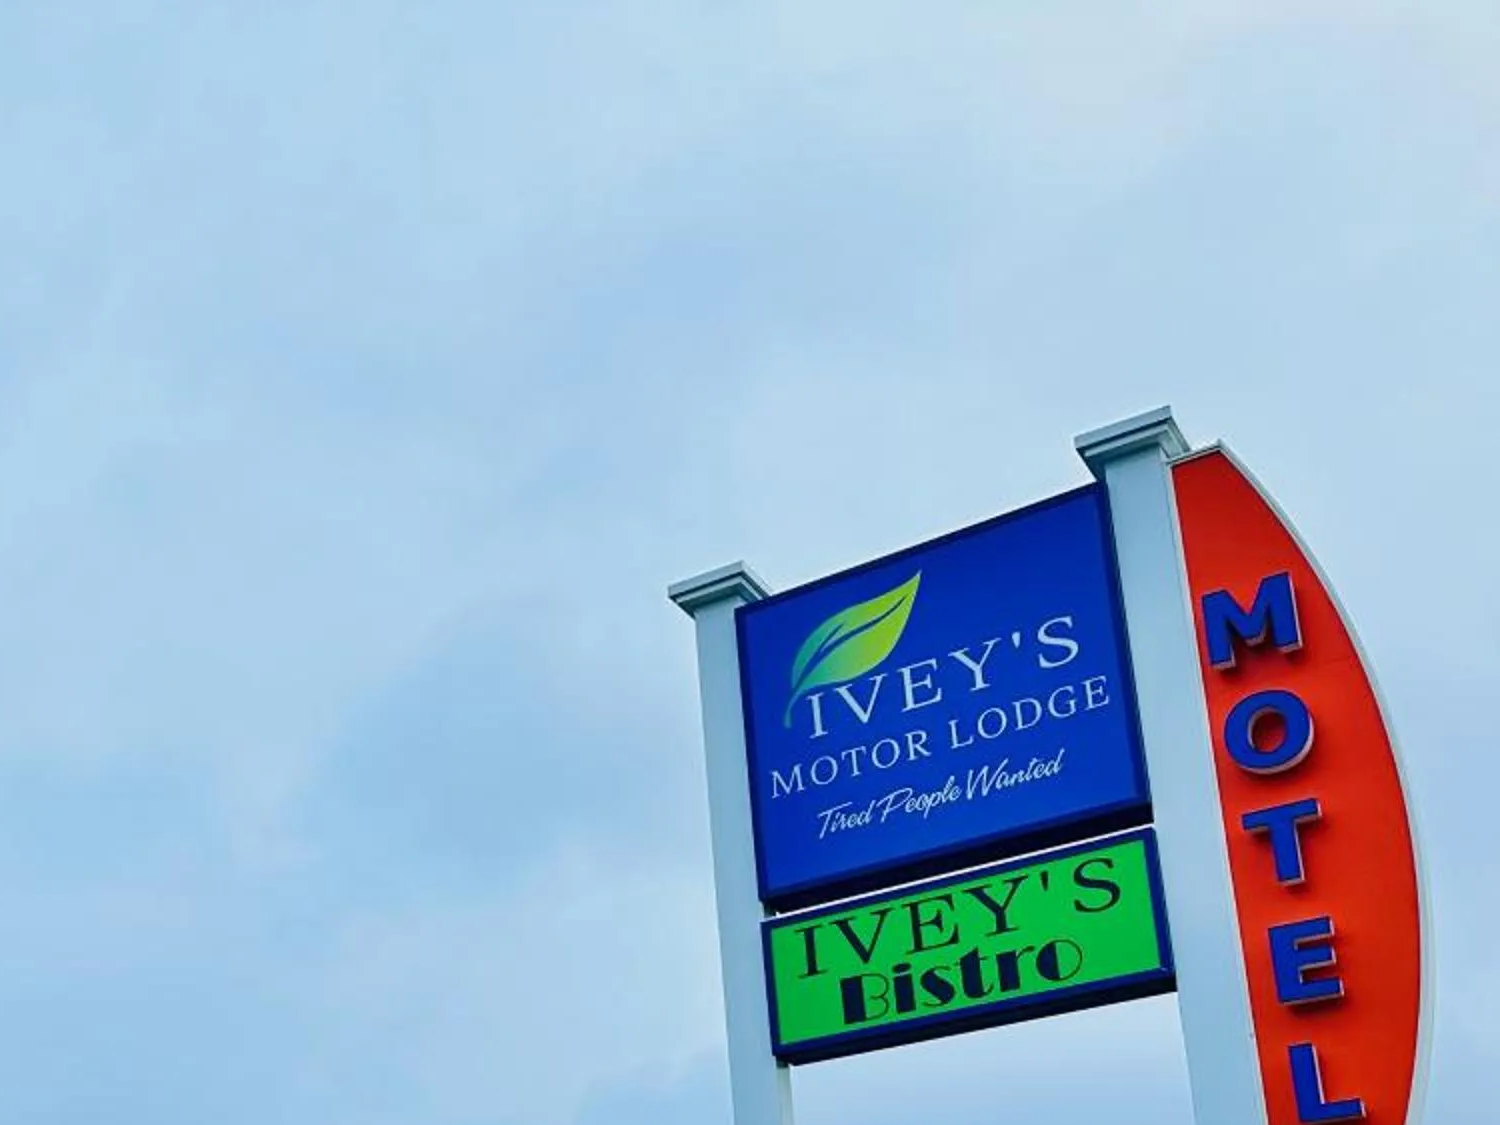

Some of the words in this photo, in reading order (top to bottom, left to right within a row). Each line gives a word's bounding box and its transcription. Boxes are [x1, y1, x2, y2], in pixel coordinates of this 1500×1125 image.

[769, 729, 932, 799] MOTOR
[948, 675, 1110, 749] LODGE
[805, 615, 1080, 739] IVEY'S
[817, 800, 876, 840] Tired
[876, 775, 963, 824] People
[965, 747, 1065, 800] Wanted
[1201, 571, 1366, 1125] MOTEL
[794, 857, 1122, 979] IVEY'S
[840, 938, 1083, 1025] Bistro
